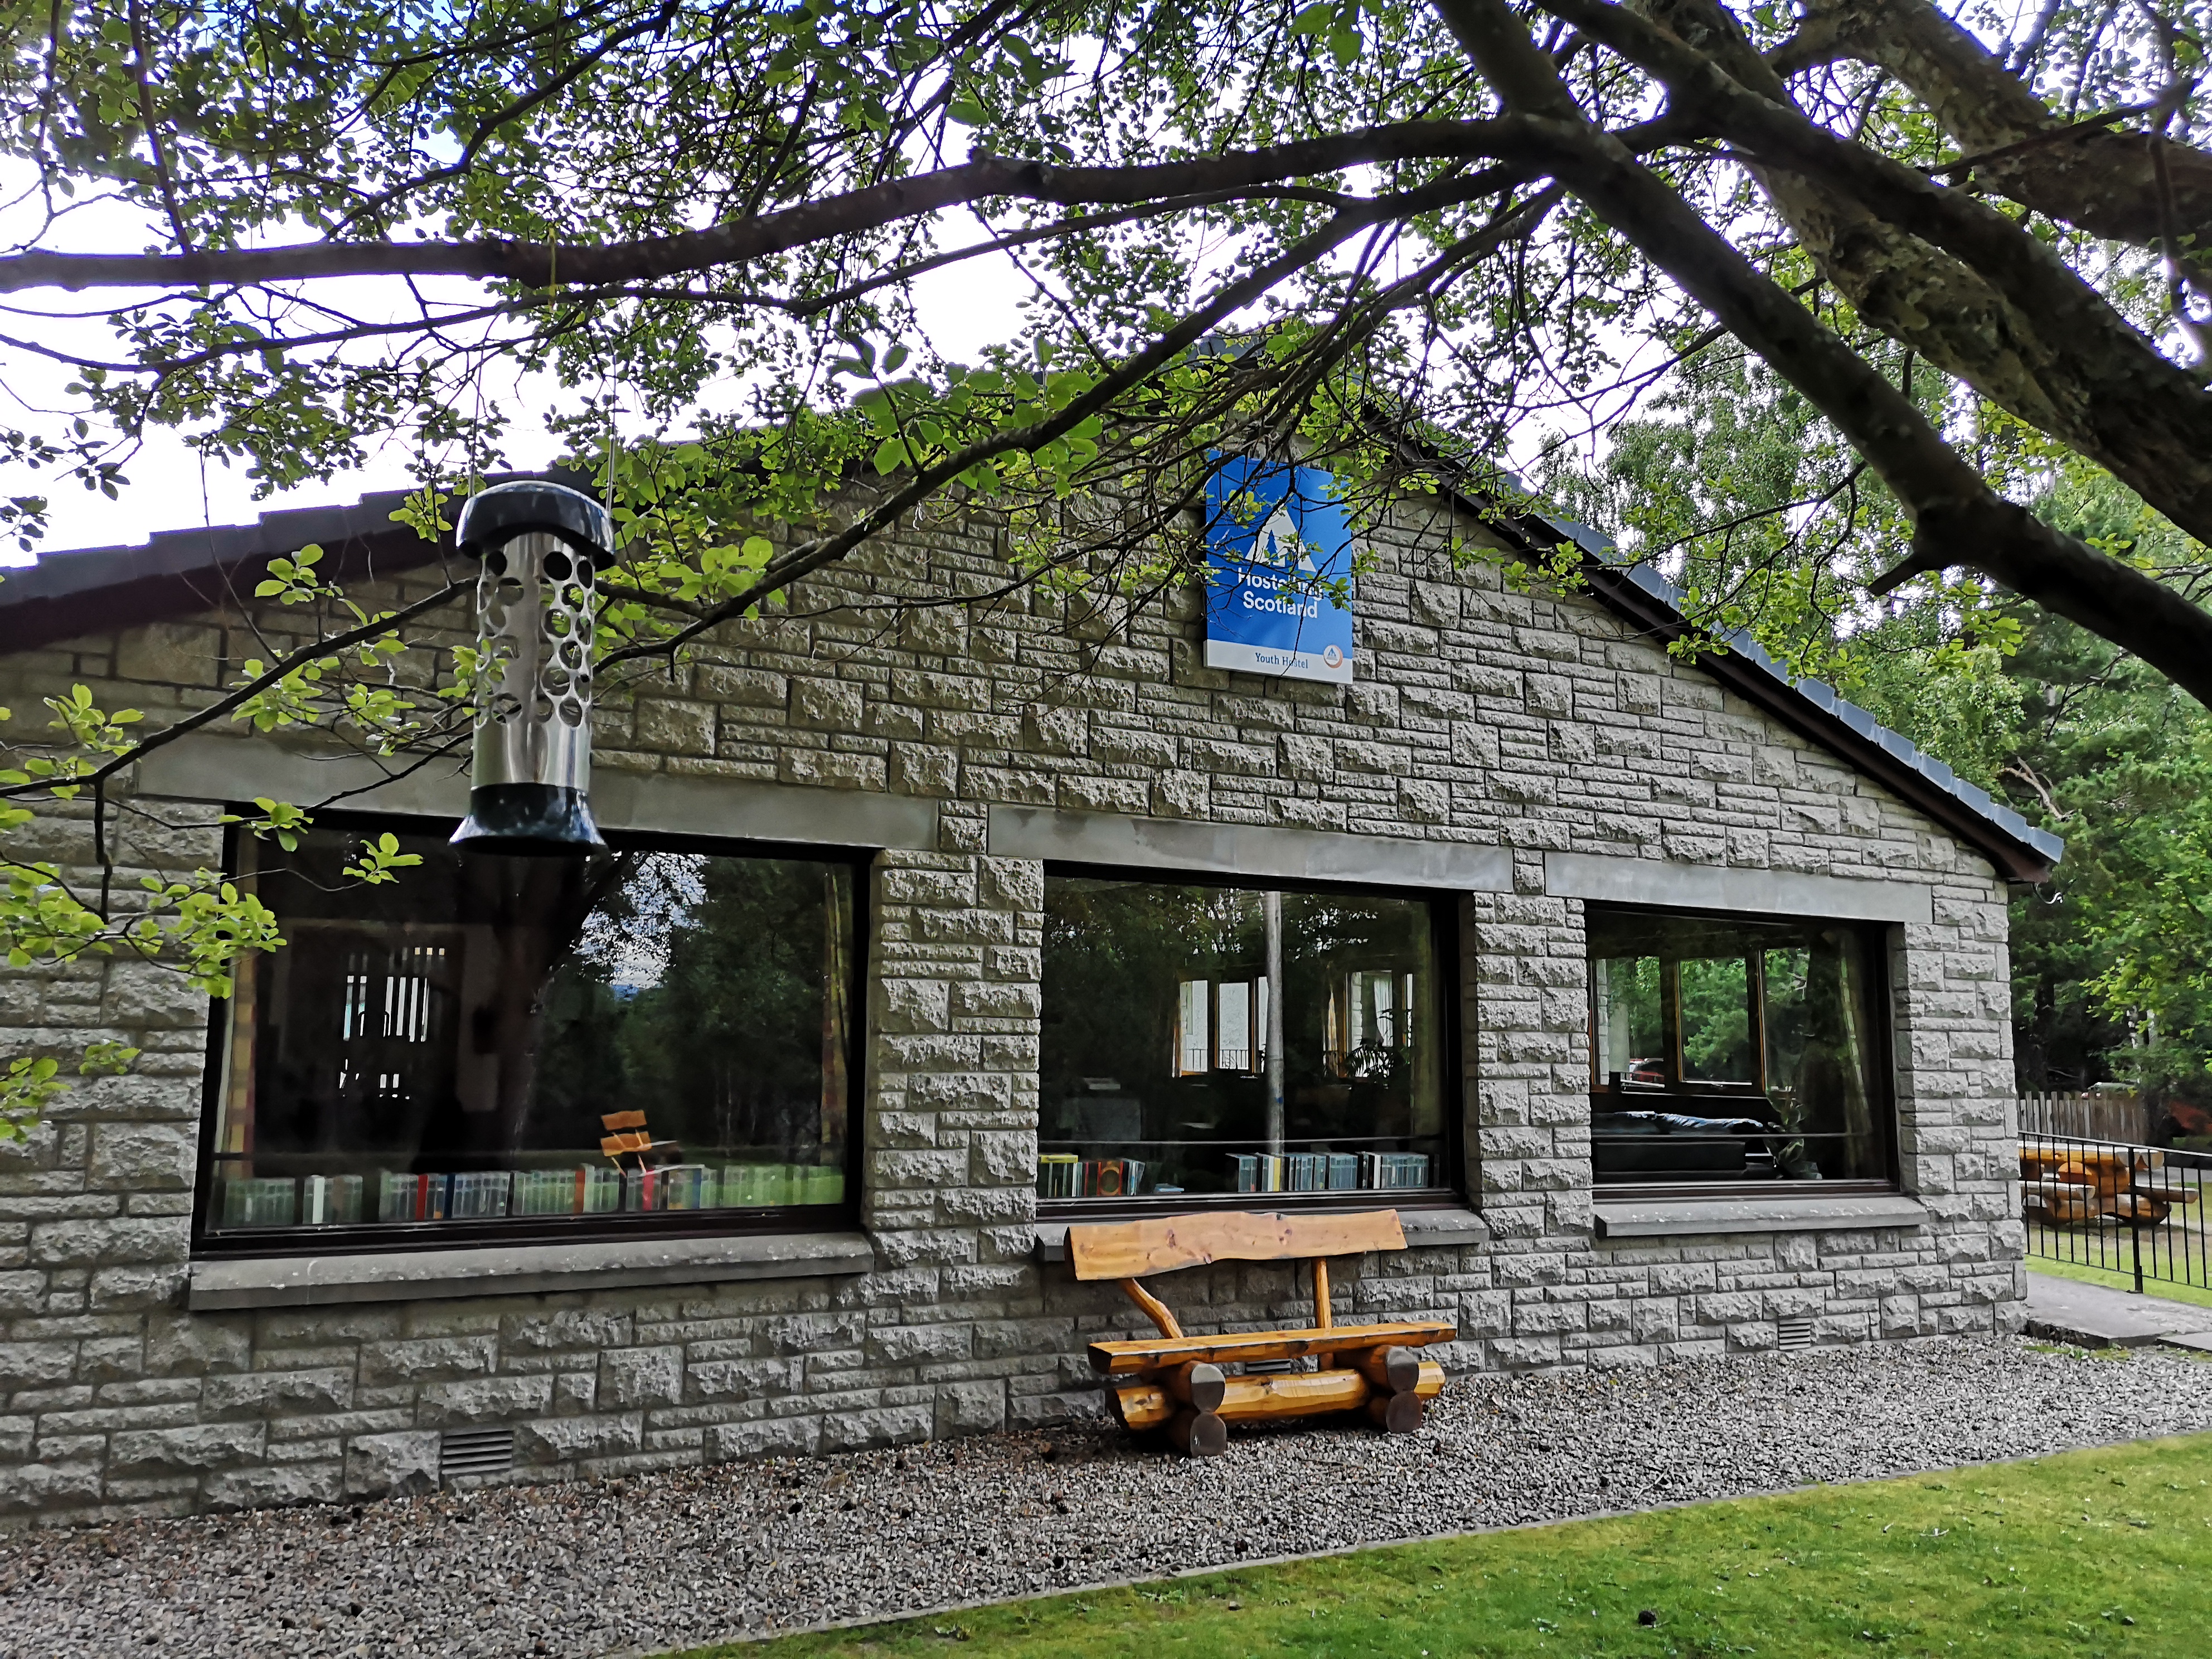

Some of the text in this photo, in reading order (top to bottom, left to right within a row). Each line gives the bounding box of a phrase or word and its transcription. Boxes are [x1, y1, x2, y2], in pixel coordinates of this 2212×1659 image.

[1243, 591, 1317, 618] Scotland
[1255, 652, 1308, 669] Youth Hostel
